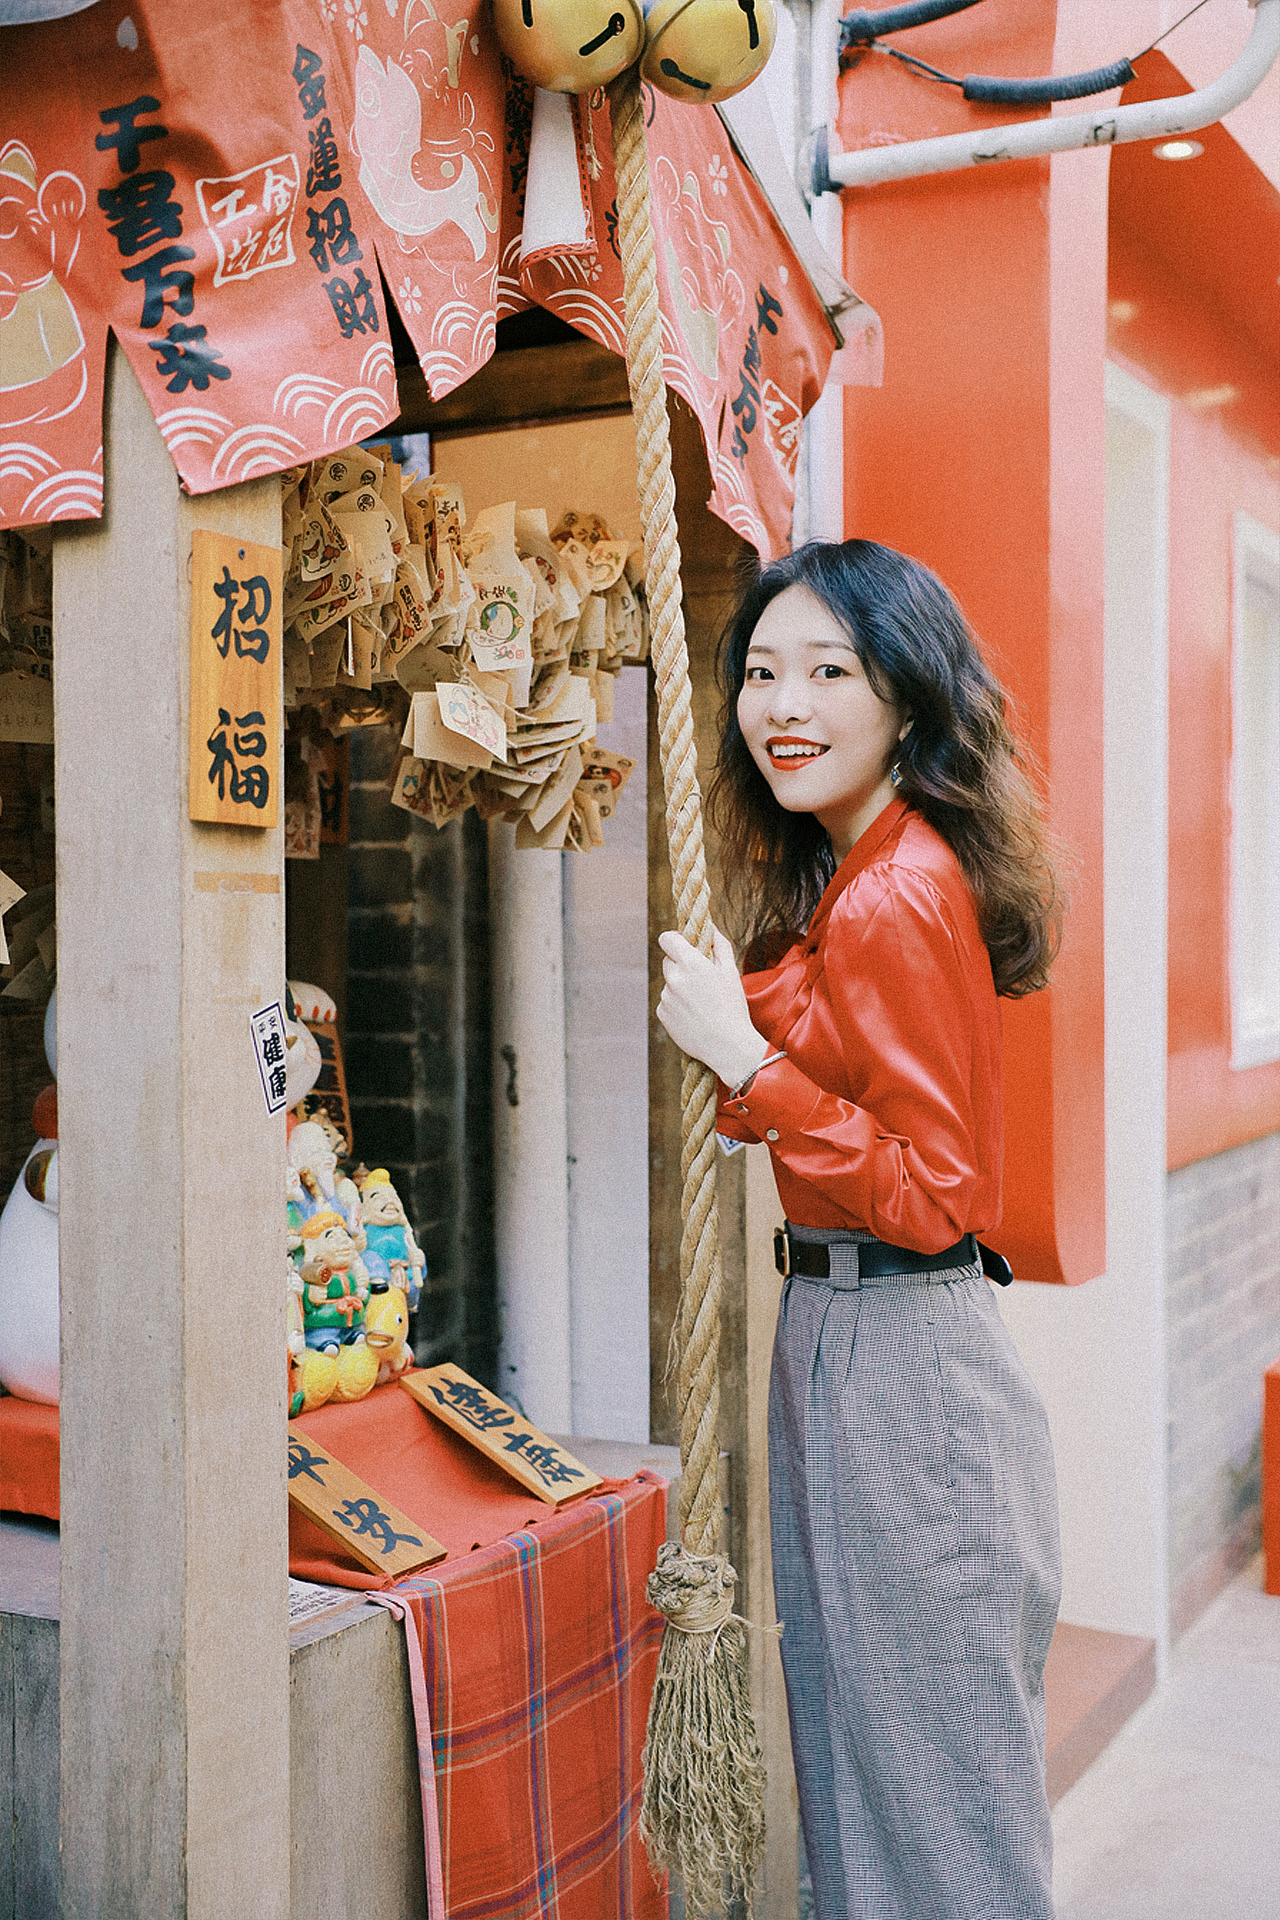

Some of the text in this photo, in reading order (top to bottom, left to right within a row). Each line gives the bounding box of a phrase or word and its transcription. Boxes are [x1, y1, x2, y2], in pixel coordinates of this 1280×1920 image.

[292, 43, 379, 340] 金運招財
[206, 565, 273, 809] 招福
[262, 1032, 287, 1100] 健康
[425, 1375, 586, 1489] 健康
